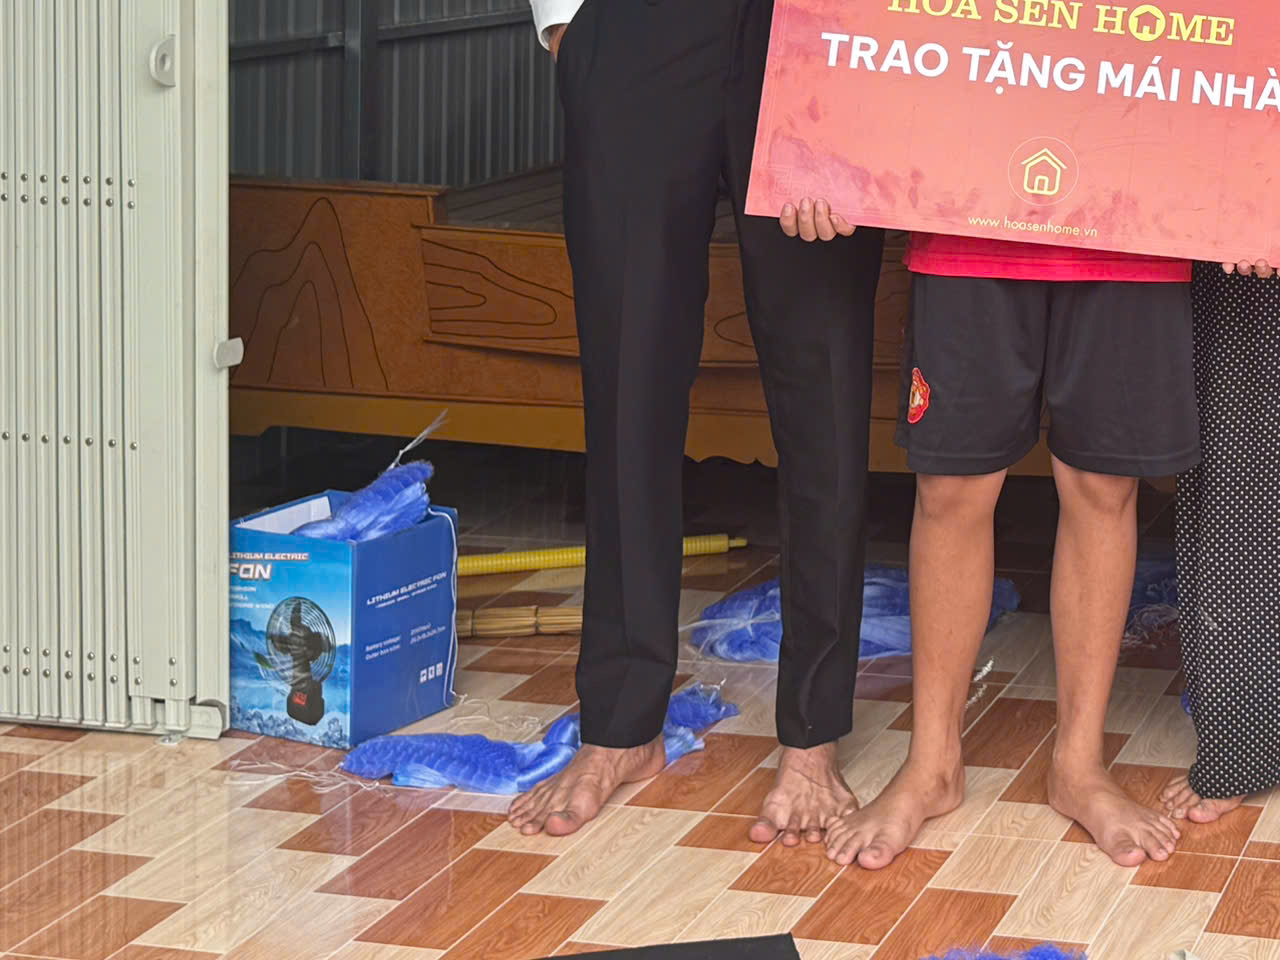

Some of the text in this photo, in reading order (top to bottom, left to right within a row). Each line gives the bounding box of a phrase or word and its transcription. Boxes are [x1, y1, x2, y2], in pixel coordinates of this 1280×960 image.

[1093, 3, 1237, 47] HOME
[820, 32, 949, 79] TRAO
[961, 40, 1087, 96] TẶNG
[1096, 55, 1181, 103] MÁI
[967, 215, 1099, 238] www.hoasenhome.vn
[264, 552, 310, 561] ELECTRIC
